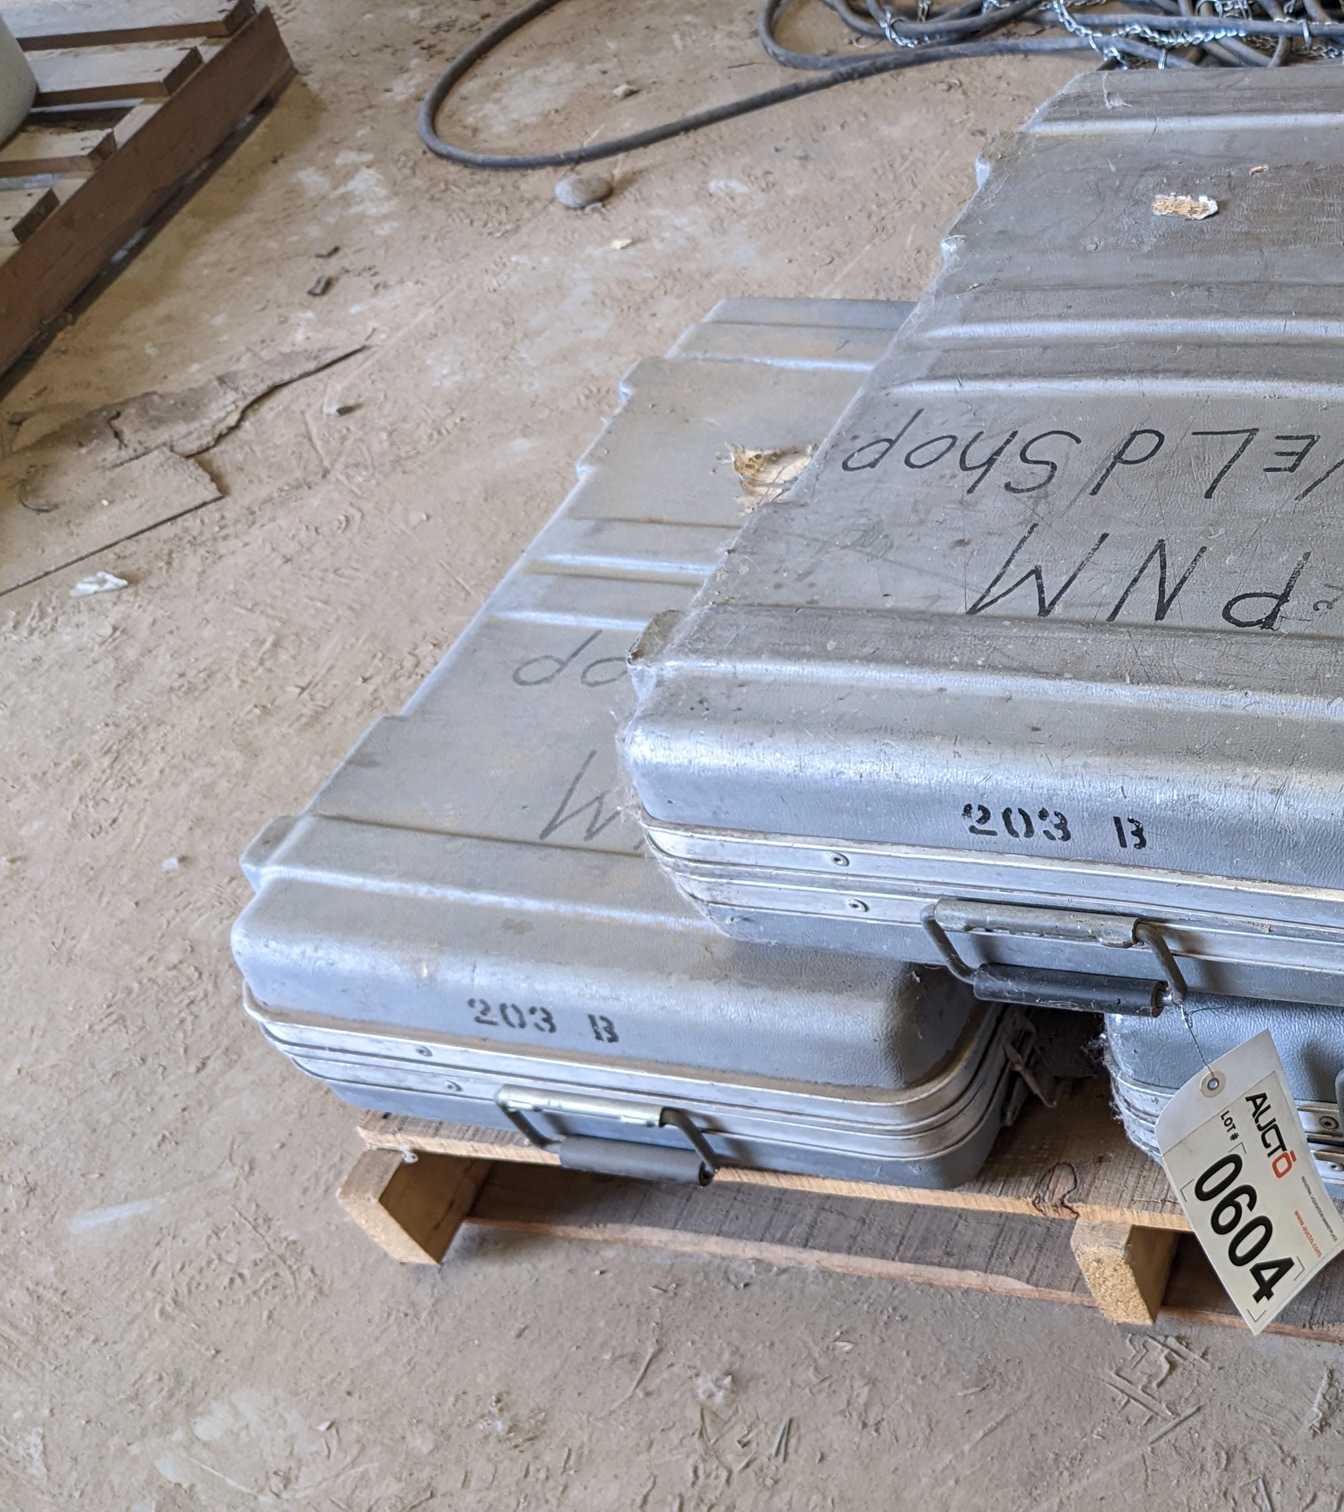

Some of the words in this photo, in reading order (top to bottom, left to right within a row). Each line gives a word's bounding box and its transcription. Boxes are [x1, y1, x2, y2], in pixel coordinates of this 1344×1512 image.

[842, 408, 1082, 494] Shop
[966, 523, 1312, 630] PNM
[512, 629, 629, 687] op
[961, 802, 1072, 842] 203
[1113, 815, 1147, 850] B
[467, 998, 557, 1034] 203
[587, 1013, 620, 1043] B
[1220, 1110, 1236, 1133] LOT
[1193, 1153, 1296, 1304] 0604
